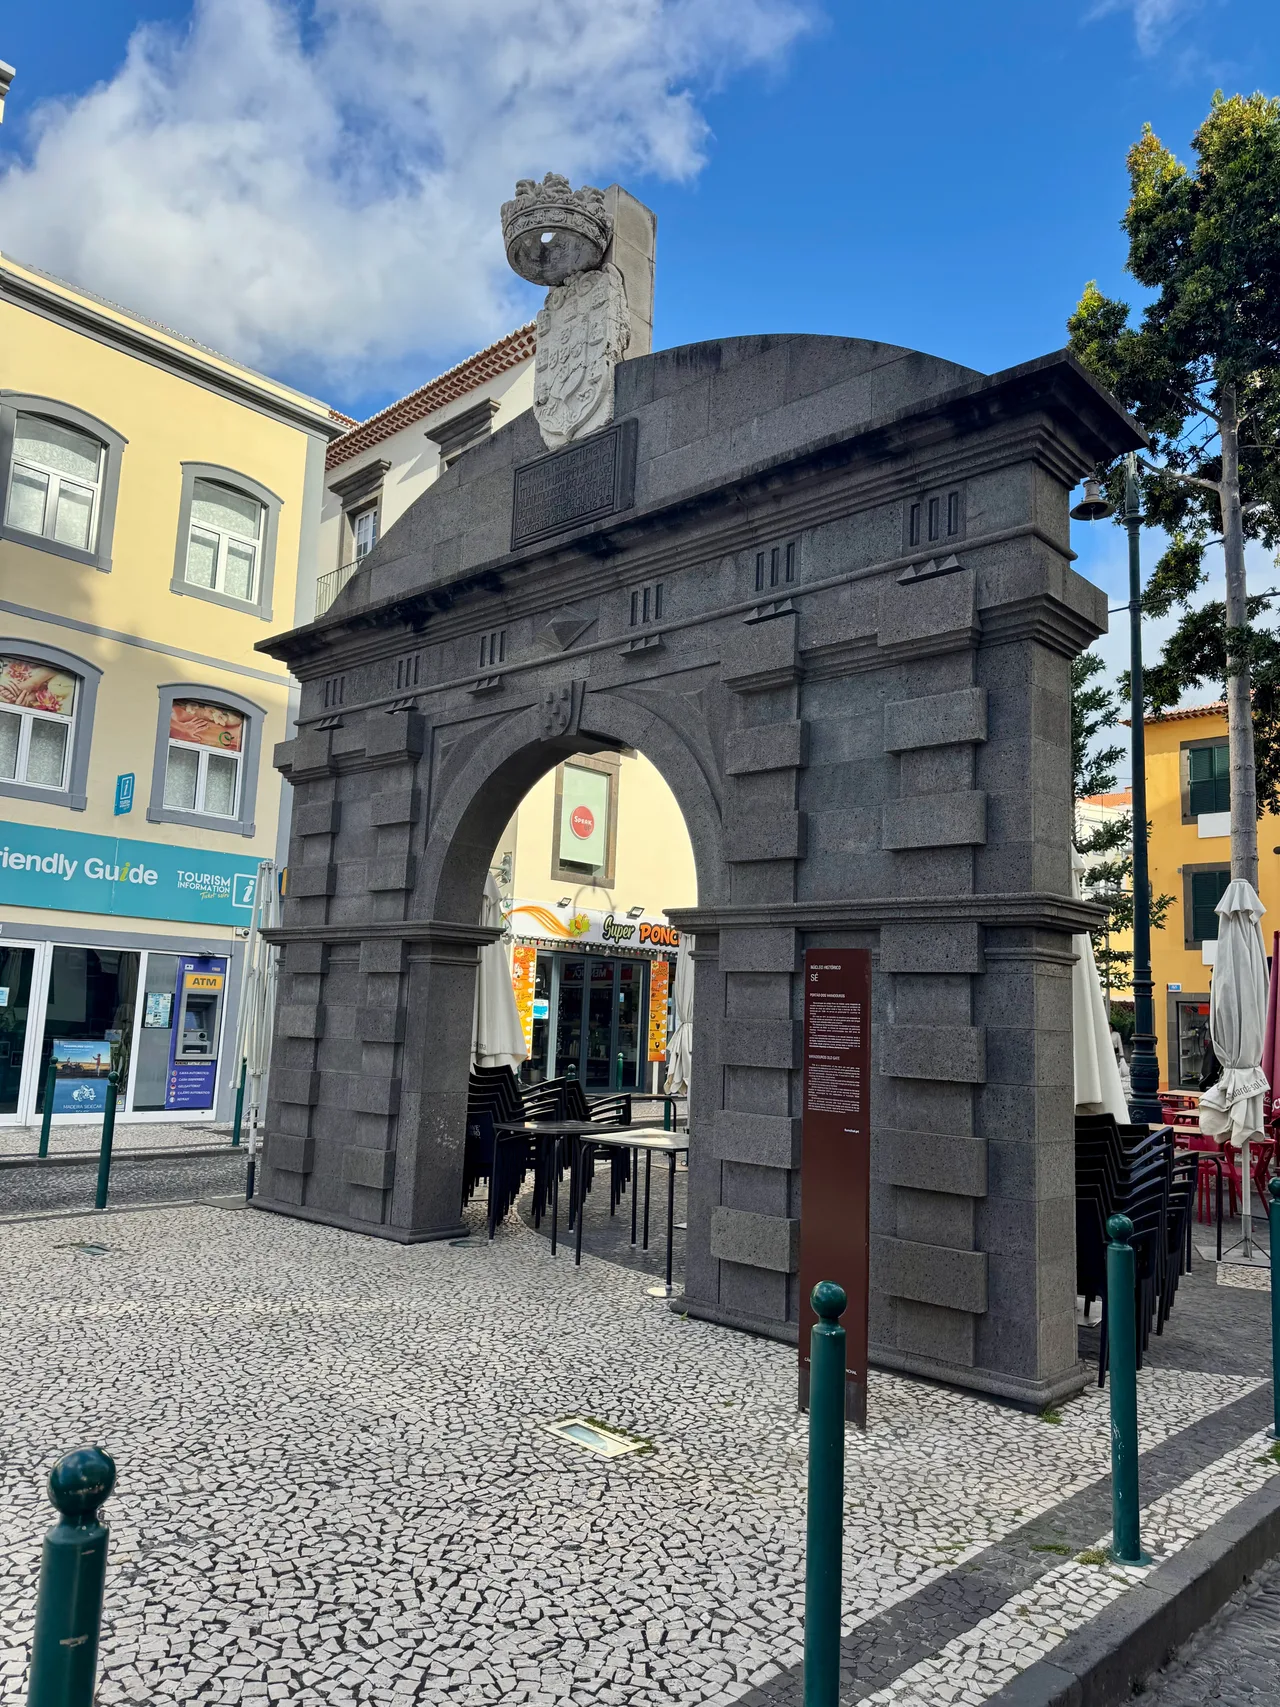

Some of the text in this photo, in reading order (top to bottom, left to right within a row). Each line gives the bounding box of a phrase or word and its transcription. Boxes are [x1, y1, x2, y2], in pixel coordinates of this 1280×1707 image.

[84, 857, 158, 886] Guide
[177, 870, 231, 887] TOURISM
[177, 881, 230, 894] INFORMATION
[602, 915, 680, 947] Super PONC
[192, 977, 217, 987] ATM
[810, 972, 819, 982] SÉ
